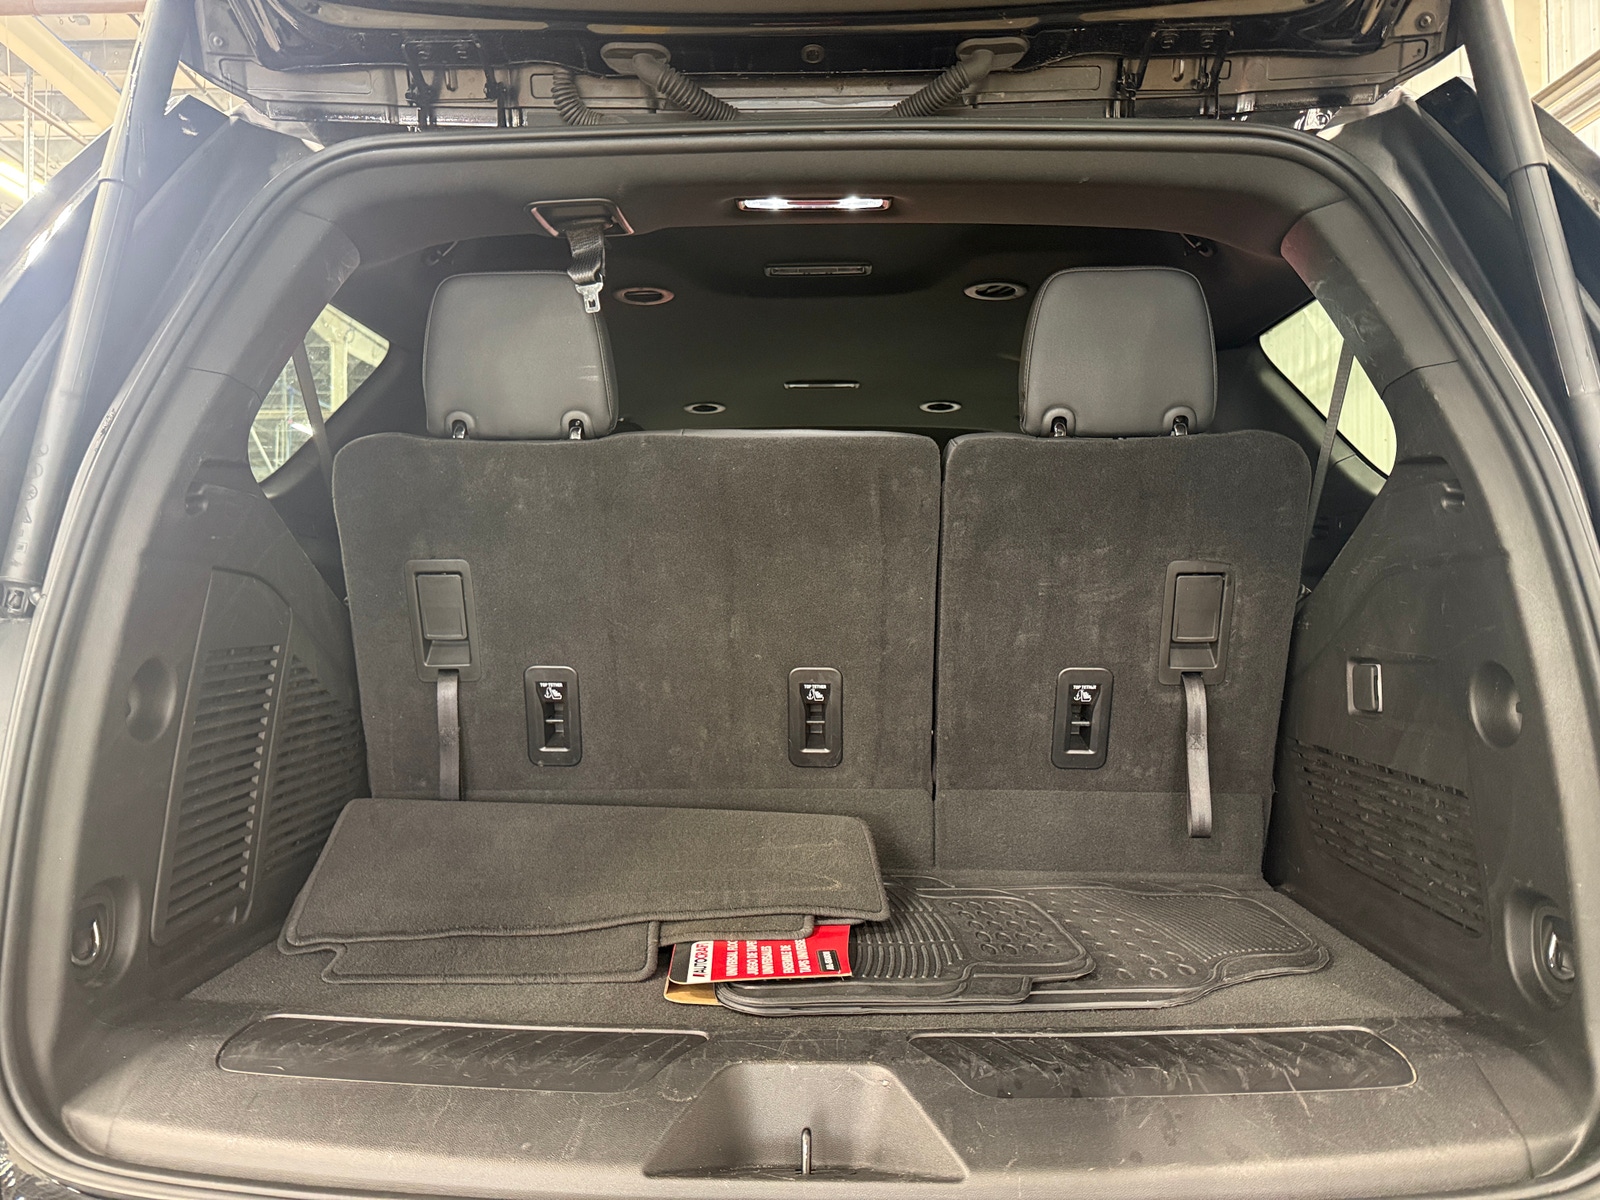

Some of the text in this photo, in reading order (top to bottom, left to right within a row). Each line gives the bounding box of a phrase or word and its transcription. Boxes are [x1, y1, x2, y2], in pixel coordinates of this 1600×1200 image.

[693, 942, 709, 974] AUTOCRAFT
[726, 952, 738, 976] UNIVERSAL
[746, 959, 759, 976] JUEGO
[761, 945, 774, 974] UNIVERSALES
[780, 951, 795, 974] ENSEMBLE
[798, 960, 812, 974] TAPIS
